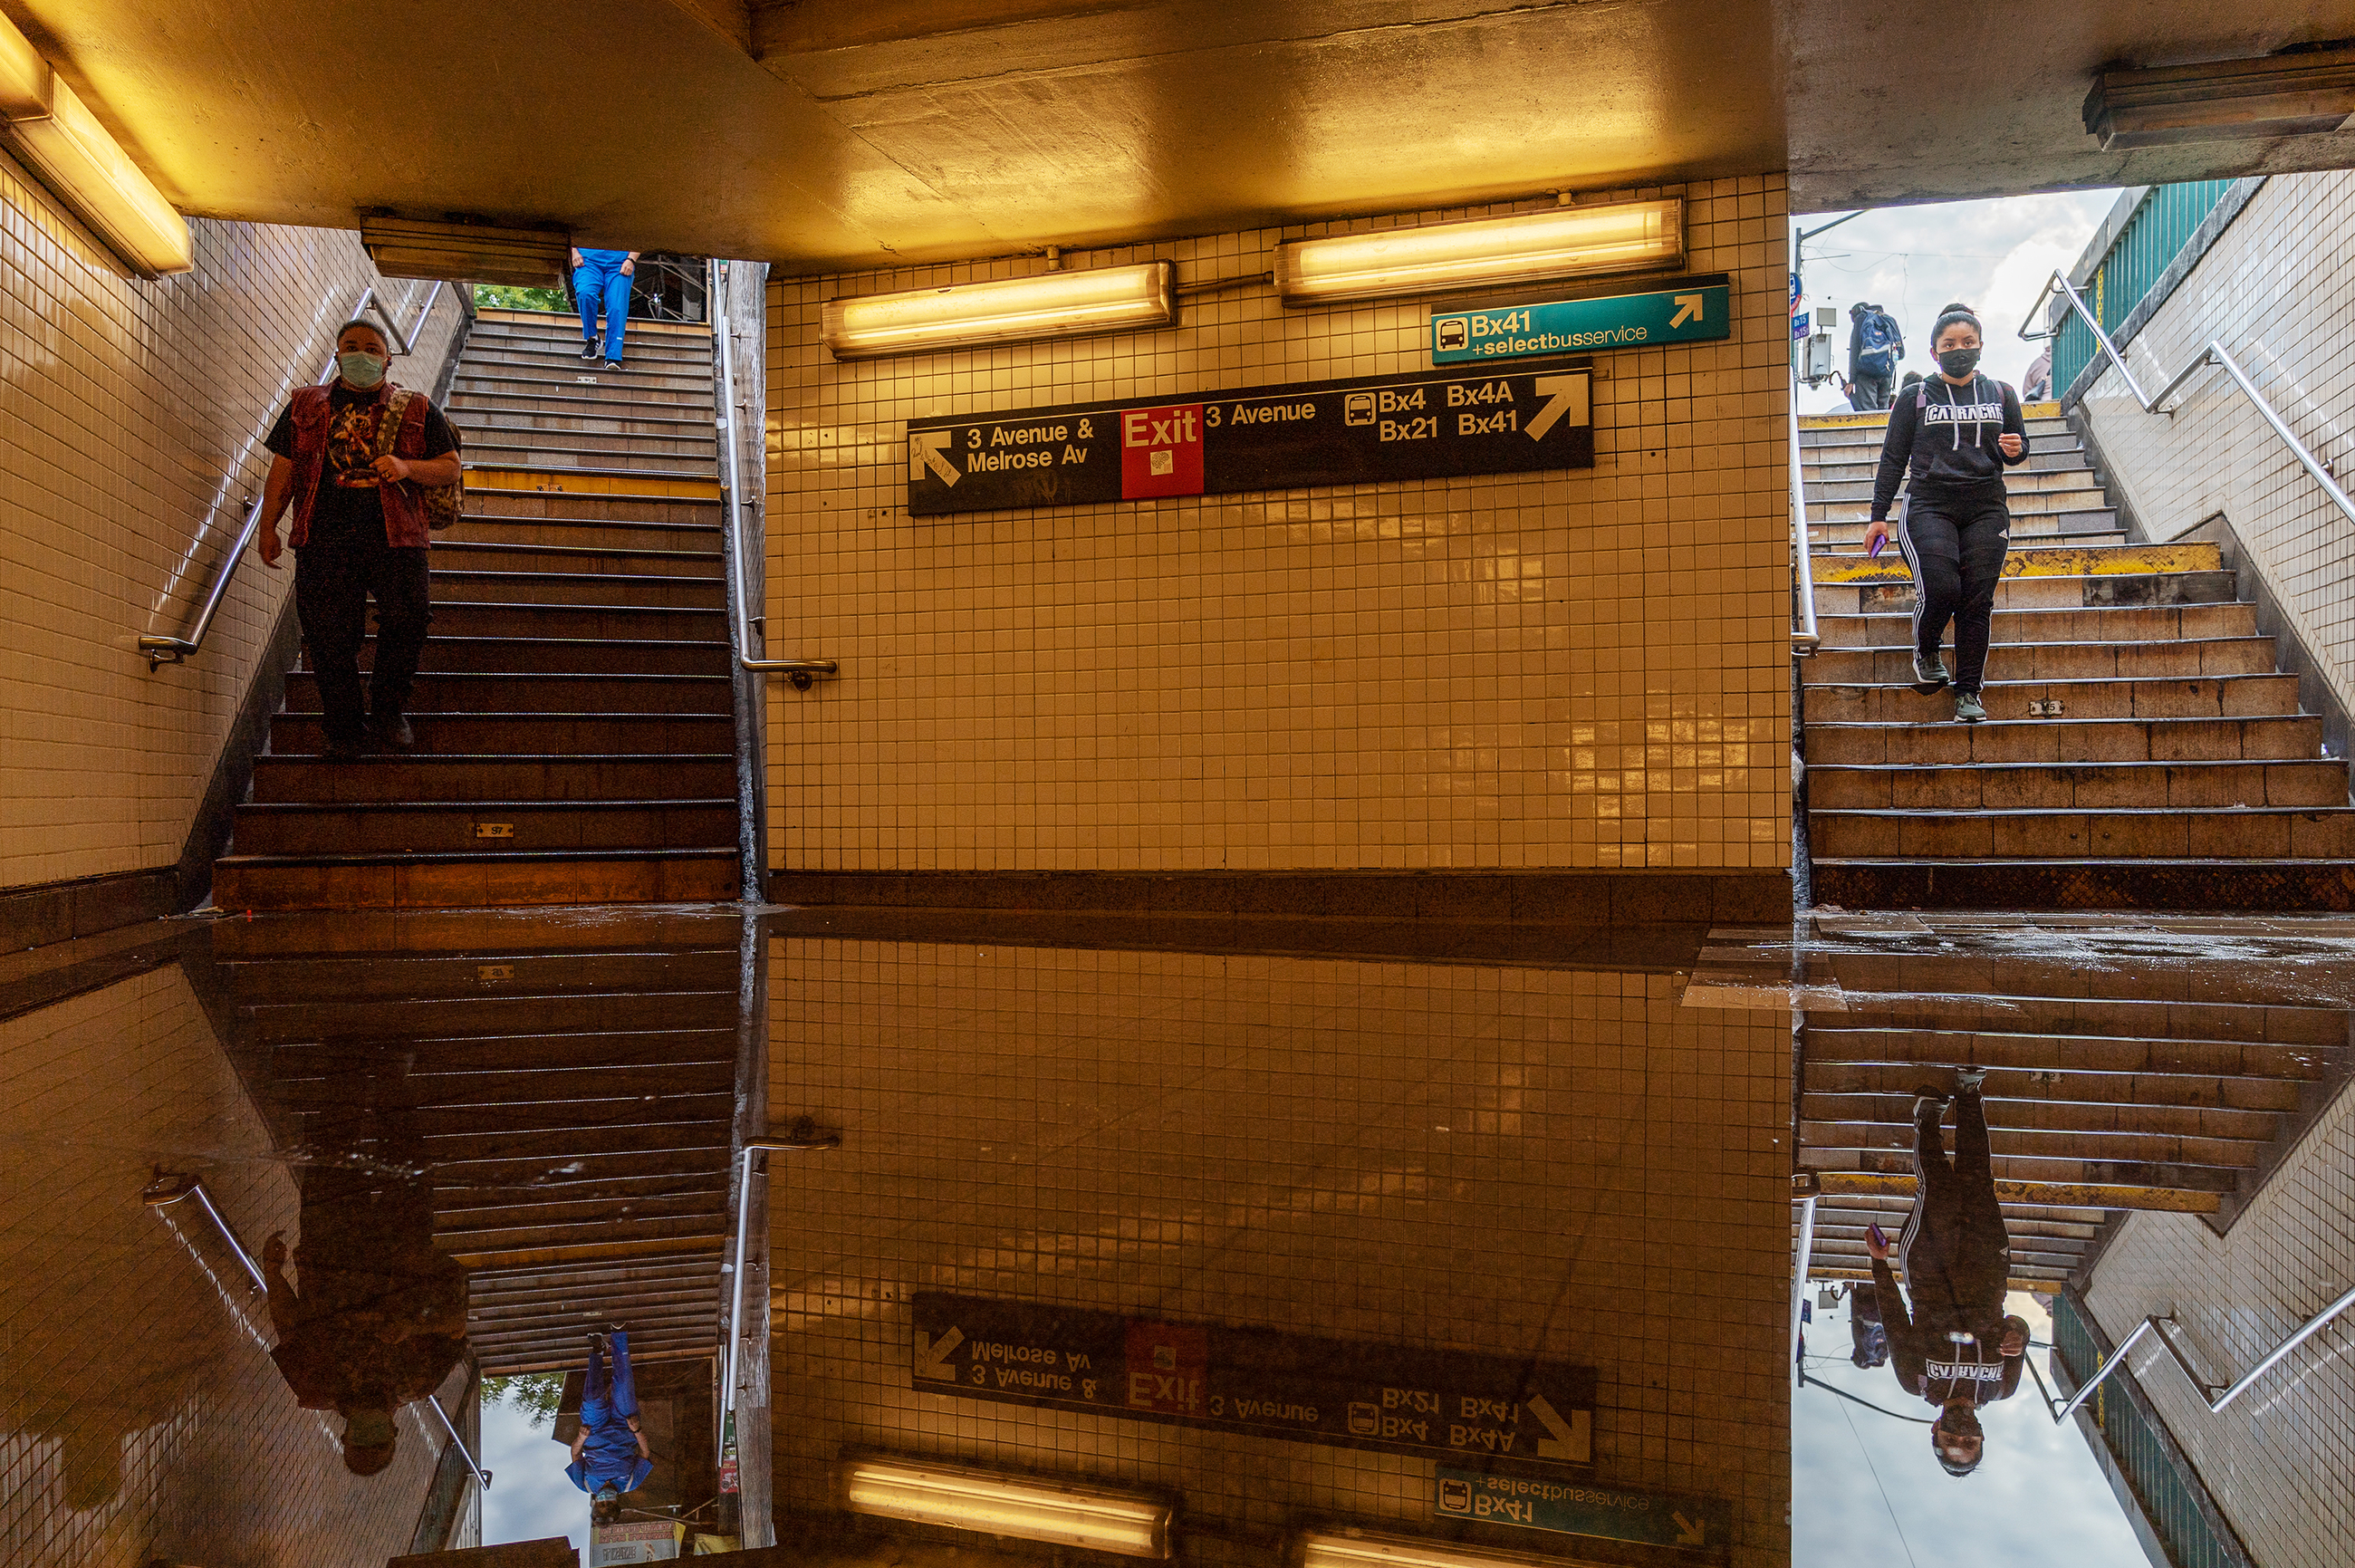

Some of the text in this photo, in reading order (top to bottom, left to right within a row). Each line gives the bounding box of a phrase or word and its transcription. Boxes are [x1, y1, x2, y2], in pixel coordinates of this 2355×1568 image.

[1471, 311, 1532, 337] Bx41
[1379, 380, 1514, 413] Bx4 Bx4A
[1124, 409, 1197, 447] Exit
[1206, 401, 1316, 428] 3 Avenue
[1379, 409, 1517, 443] Bx21 Bx41
[967, 418, 1094, 448] 3 Avenue &
[967, 449, 1053, 473] Melrose
[1062, 444, 1088, 465] Av
